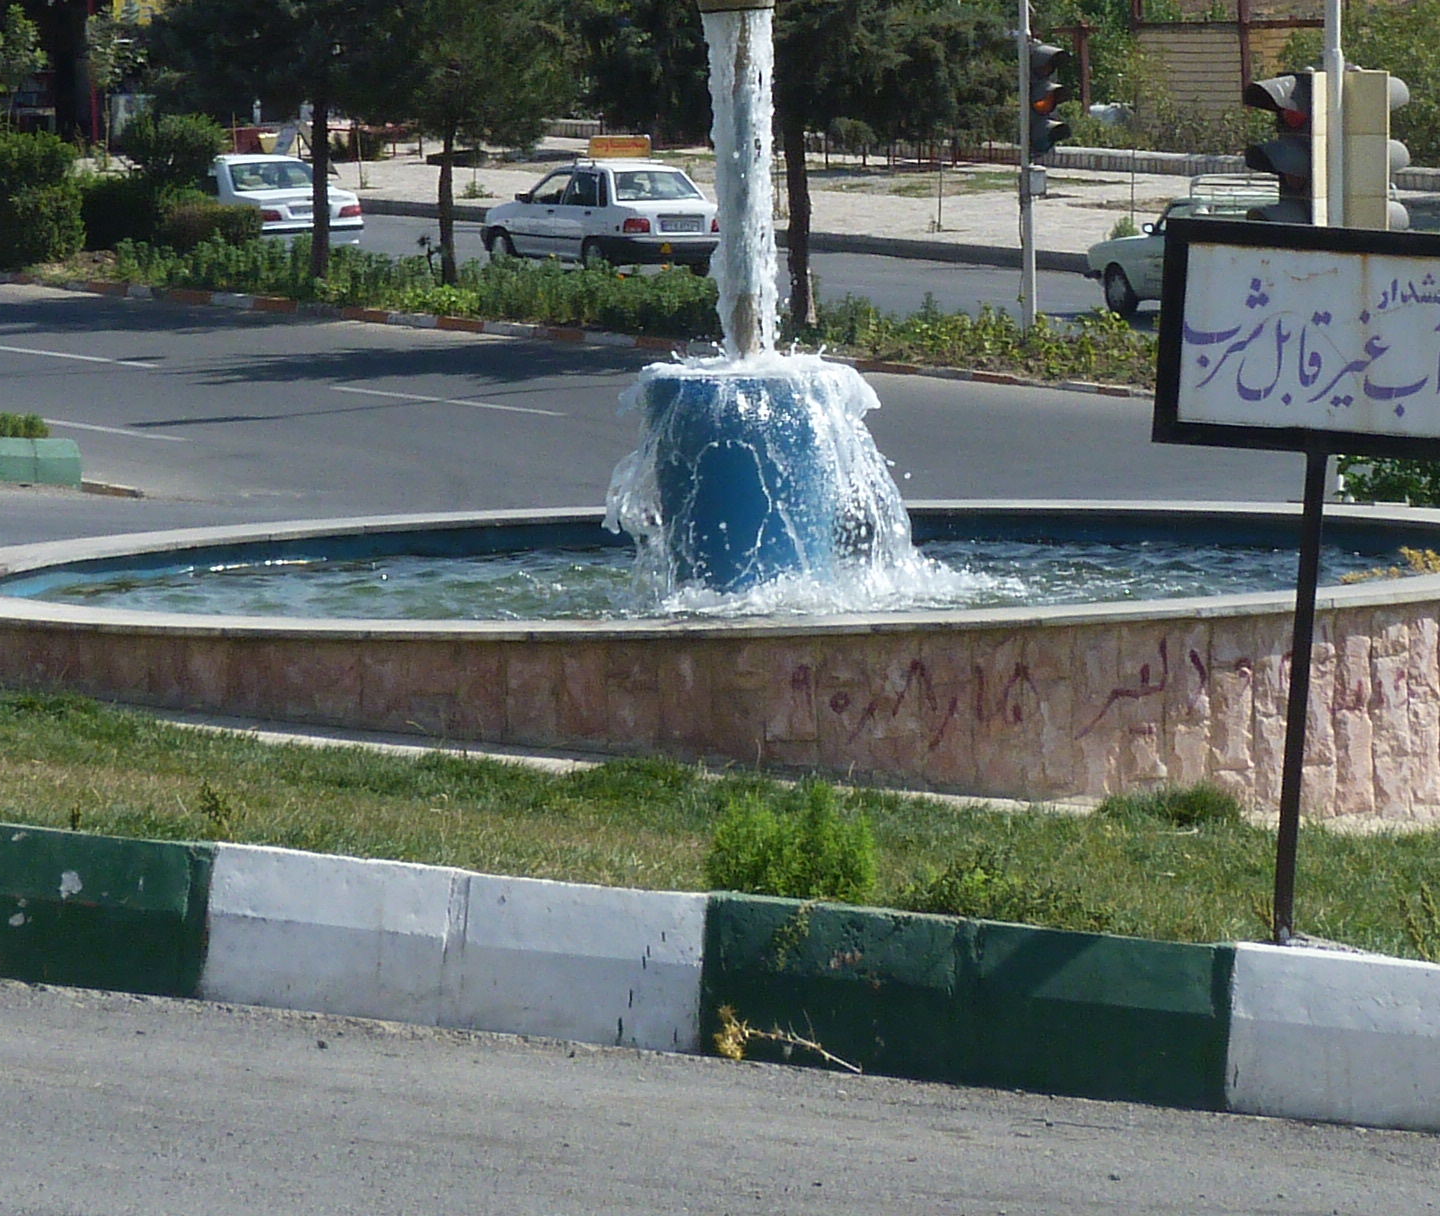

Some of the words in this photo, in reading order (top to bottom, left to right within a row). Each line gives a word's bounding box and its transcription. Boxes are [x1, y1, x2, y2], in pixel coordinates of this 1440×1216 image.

[1182, 277, 1270, 389] شرب
[1236, 310, 1333, 407] قابل
[1307, 309, 1391, 407] غیر
